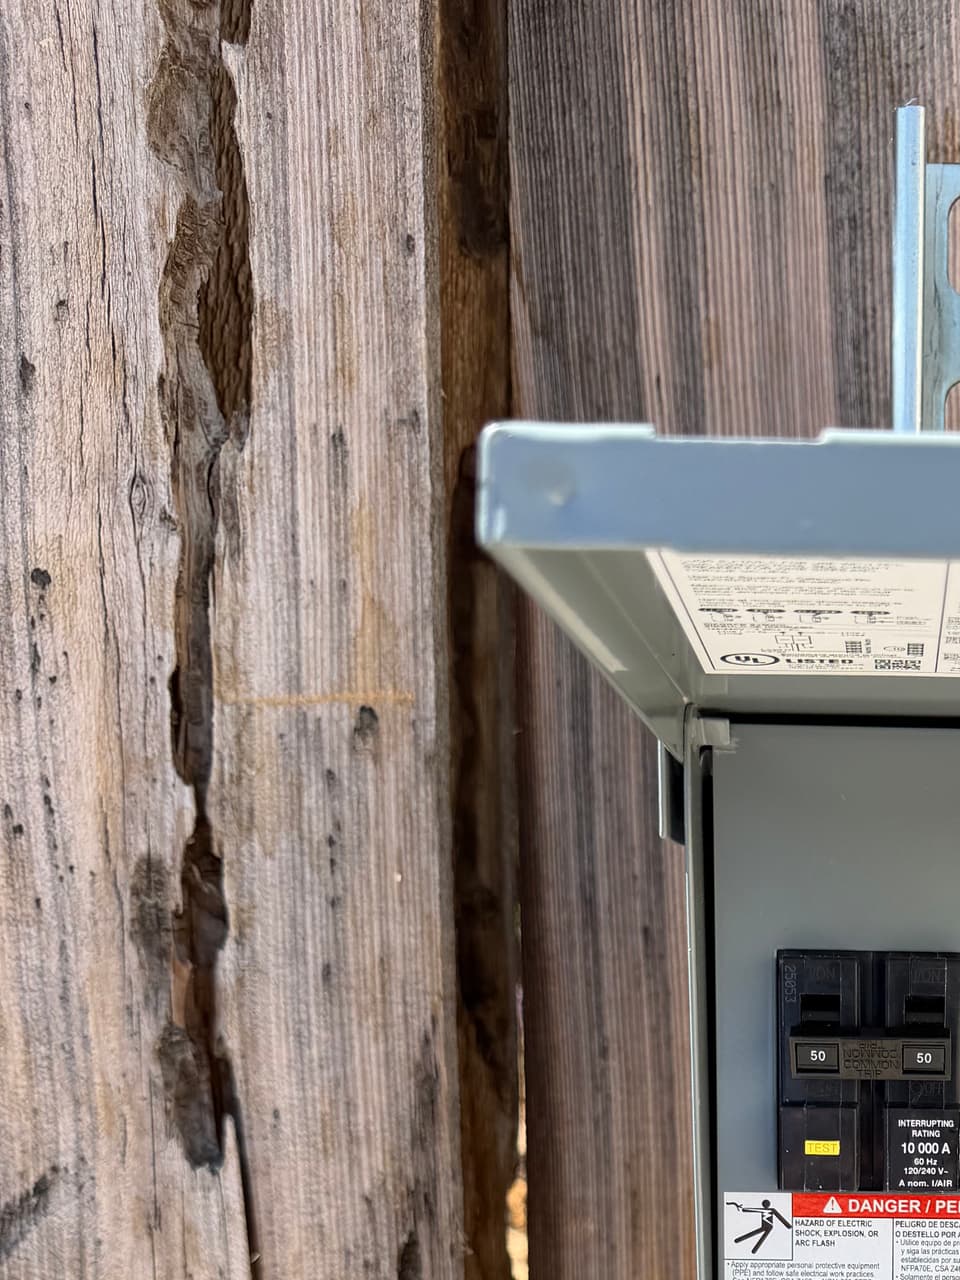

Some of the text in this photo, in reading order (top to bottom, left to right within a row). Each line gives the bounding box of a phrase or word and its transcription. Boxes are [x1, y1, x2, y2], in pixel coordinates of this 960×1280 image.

[810, 1051, 826, 1061] 50
[916, 1053, 932, 1063] 50
[843, 1060, 899, 1069] COMMON
[807, 1143, 838, 1152] TEST
[901, 1144, 950, 1154] 10 000 A
[903, 1167, 936, 1175] 120/240
[931, 1179, 952, 1187] I/AIR
[848, 1200, 922, 1213] DANGER
[787, 1262, 813, 1270] personal
